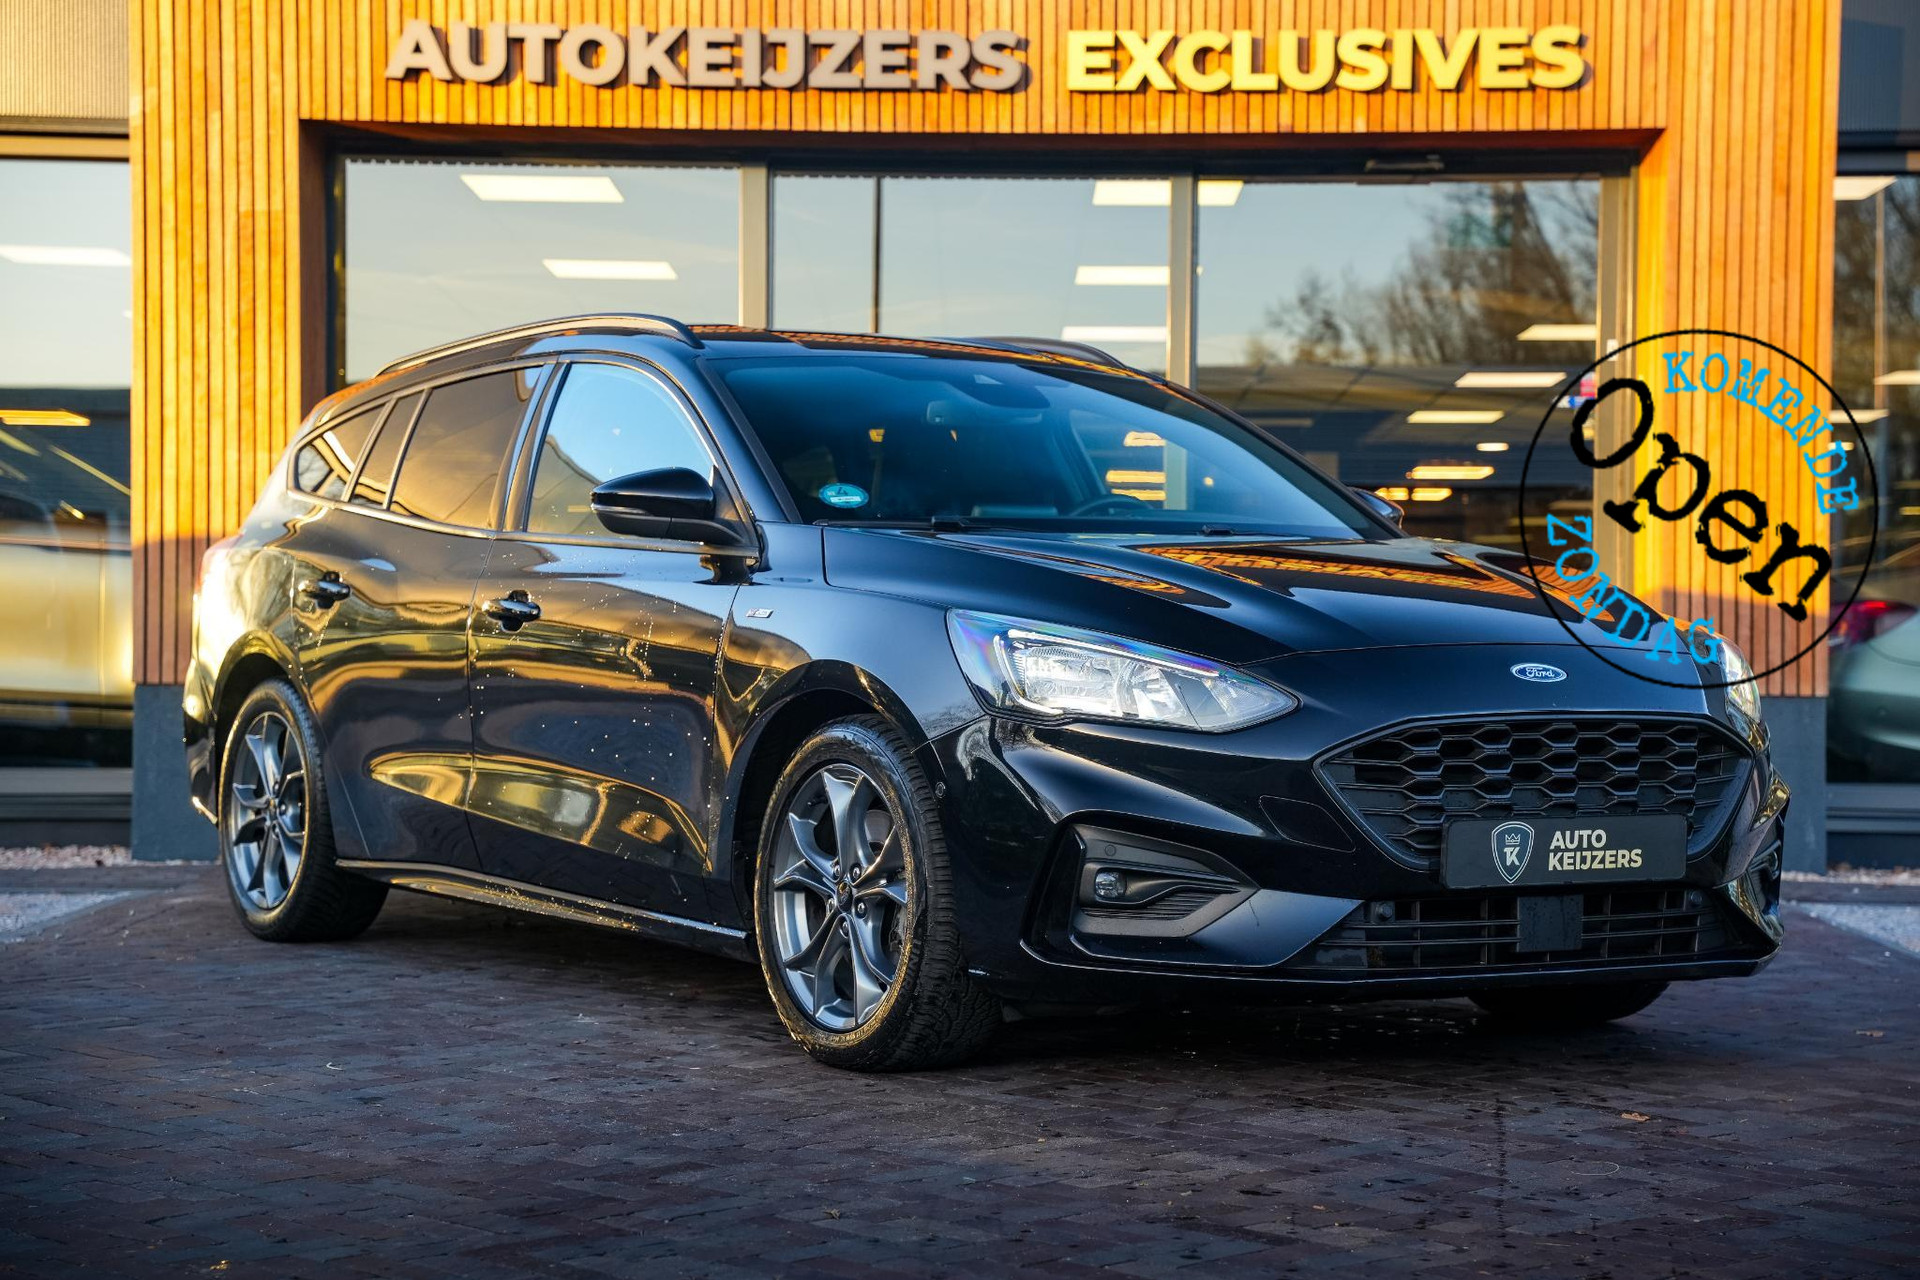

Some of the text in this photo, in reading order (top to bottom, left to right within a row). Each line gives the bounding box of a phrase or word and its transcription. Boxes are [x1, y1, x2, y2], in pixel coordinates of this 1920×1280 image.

[385, 19, 1587, 93] AUTOKEIJZERS EXCLUSIVES
[1525, 666, 1555, 678] Ford
[1549, 829, 1607, 850] AUTO
[1548, 848, 1643, 871] KEIJZERS
